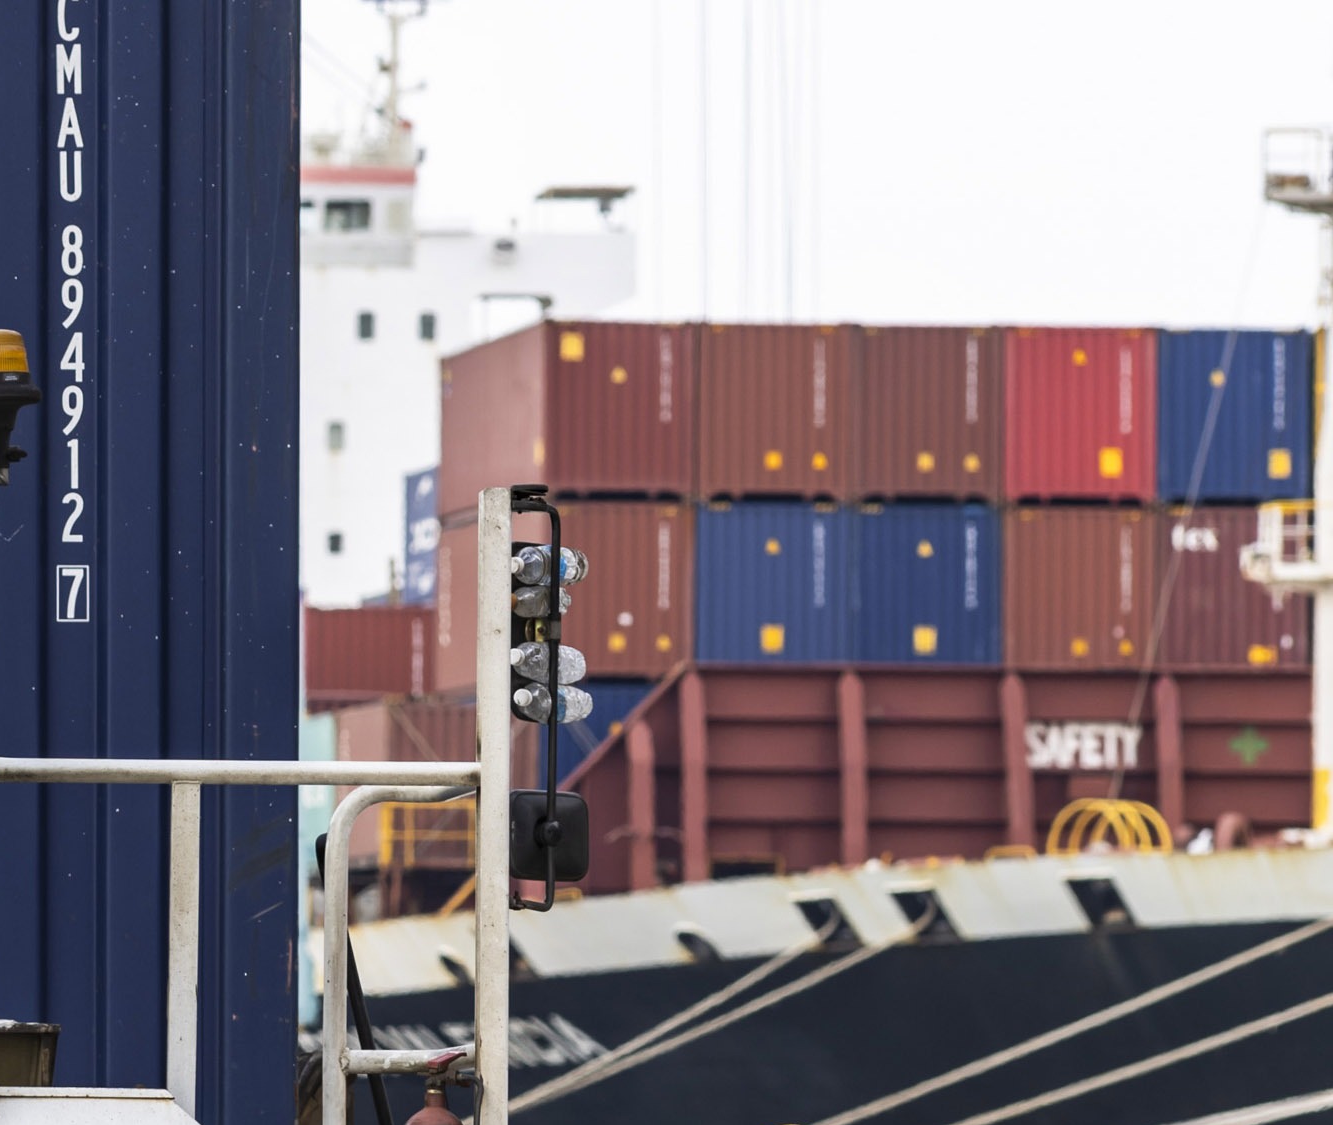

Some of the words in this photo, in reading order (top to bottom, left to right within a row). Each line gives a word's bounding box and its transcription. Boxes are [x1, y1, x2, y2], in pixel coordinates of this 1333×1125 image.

[55, 0, 84, 203] CMAU
[59, 224, 85, 543] 894912
[59, 567, 86, 620] 7
[1025, 722, 1142, 769] SAFETY
